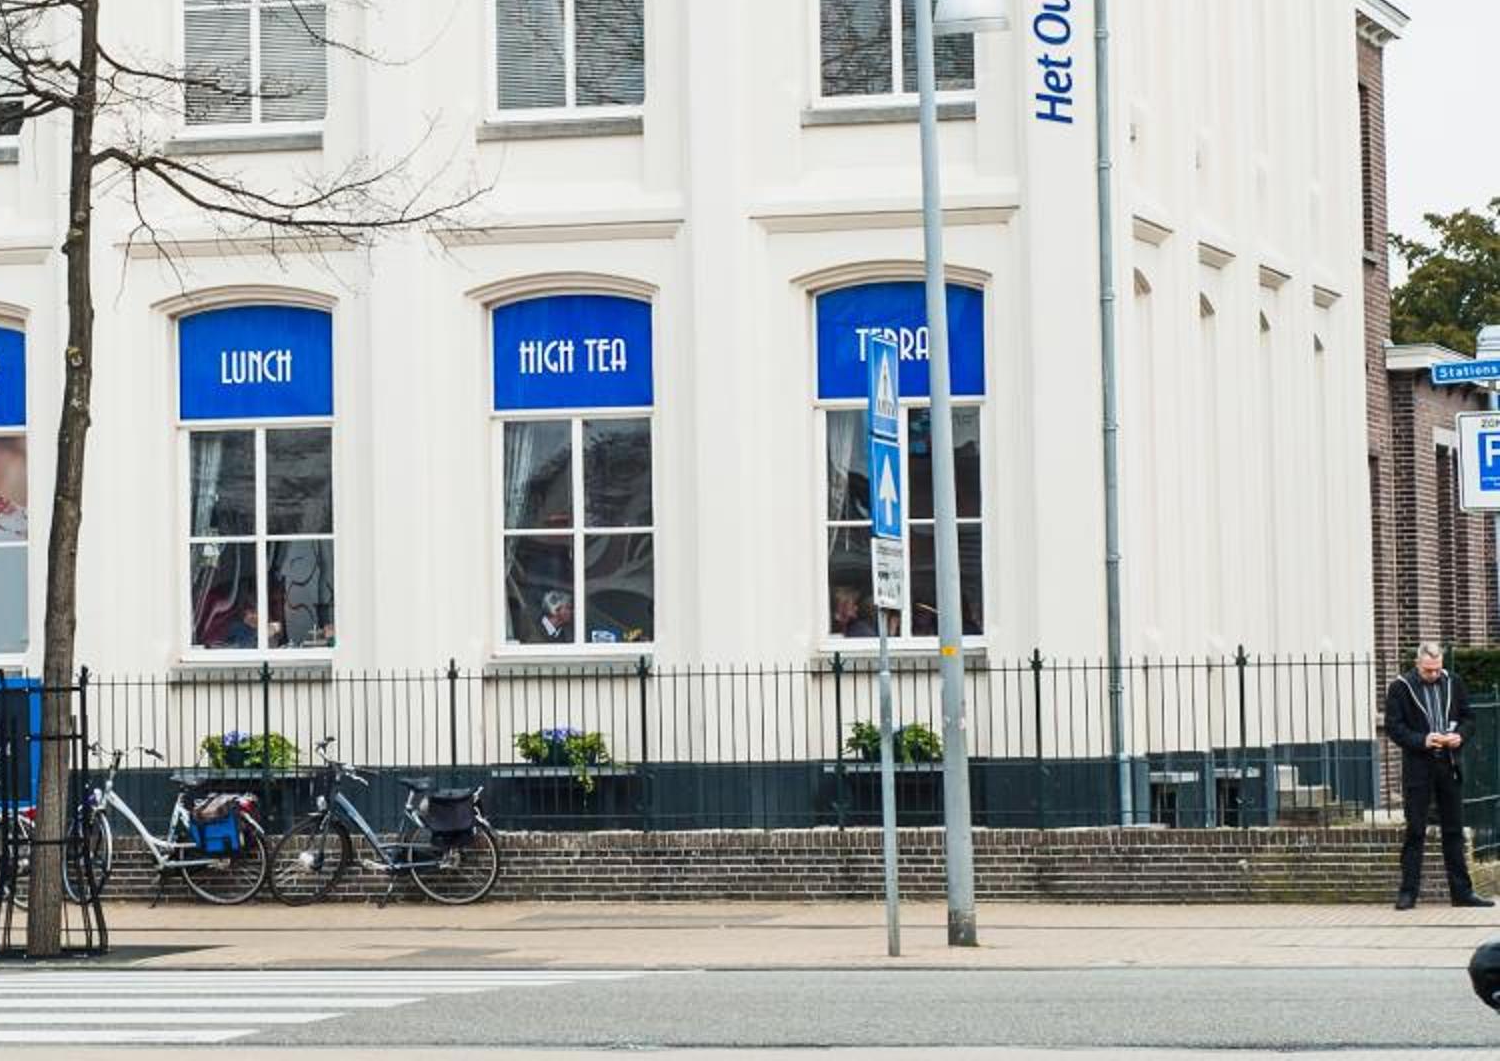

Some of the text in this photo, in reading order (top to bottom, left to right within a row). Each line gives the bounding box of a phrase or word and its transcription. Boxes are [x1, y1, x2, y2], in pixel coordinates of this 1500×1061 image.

[1035, 54, 1073, 124] Het
[221, 349, 292, 384] LUNCH
[519, 338, 627, 374] HIGH TEA
